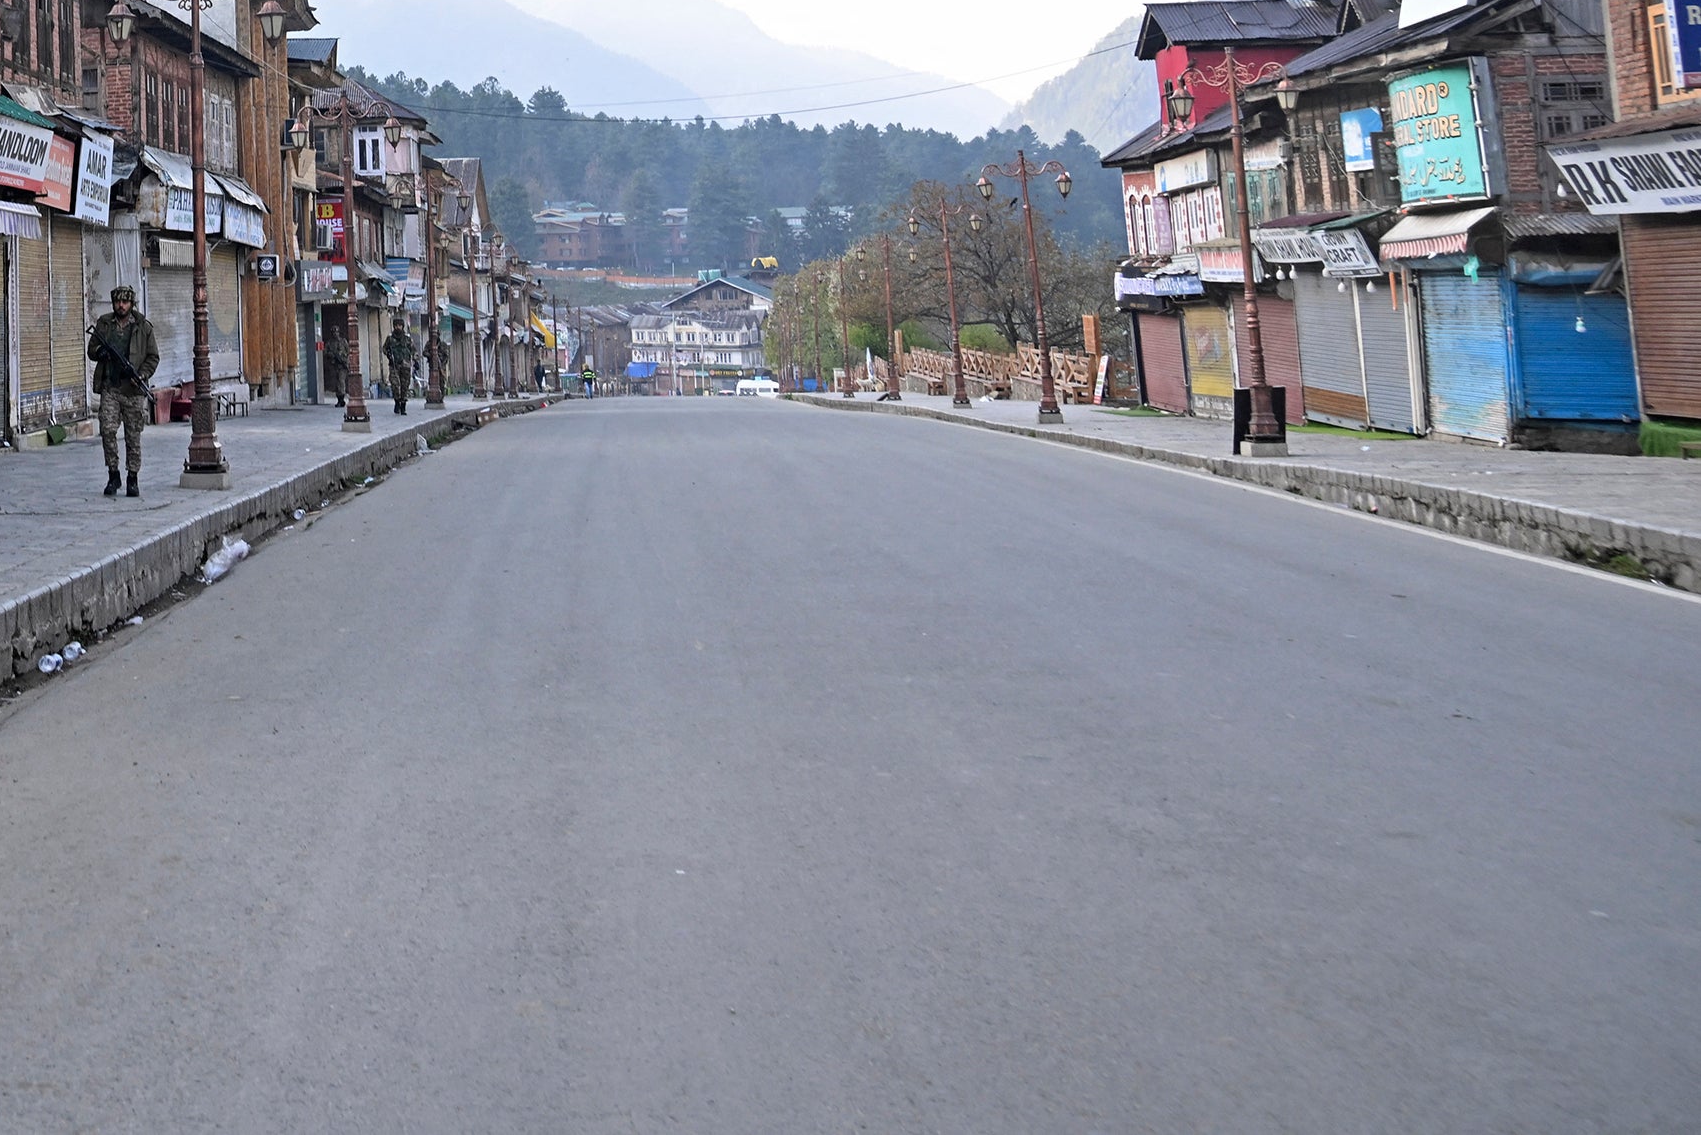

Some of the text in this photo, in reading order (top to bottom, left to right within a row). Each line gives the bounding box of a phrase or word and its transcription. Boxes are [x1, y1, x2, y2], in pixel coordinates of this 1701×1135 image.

[1415, 114, 1461, 143] STORE
[86, 149, 107, 180] AMAR
[1608, 152, 1686, 192] SHAWL
[1321, 232, 1350, 246] CROWN
[1326, 247, 1360, 264] CRAFT
